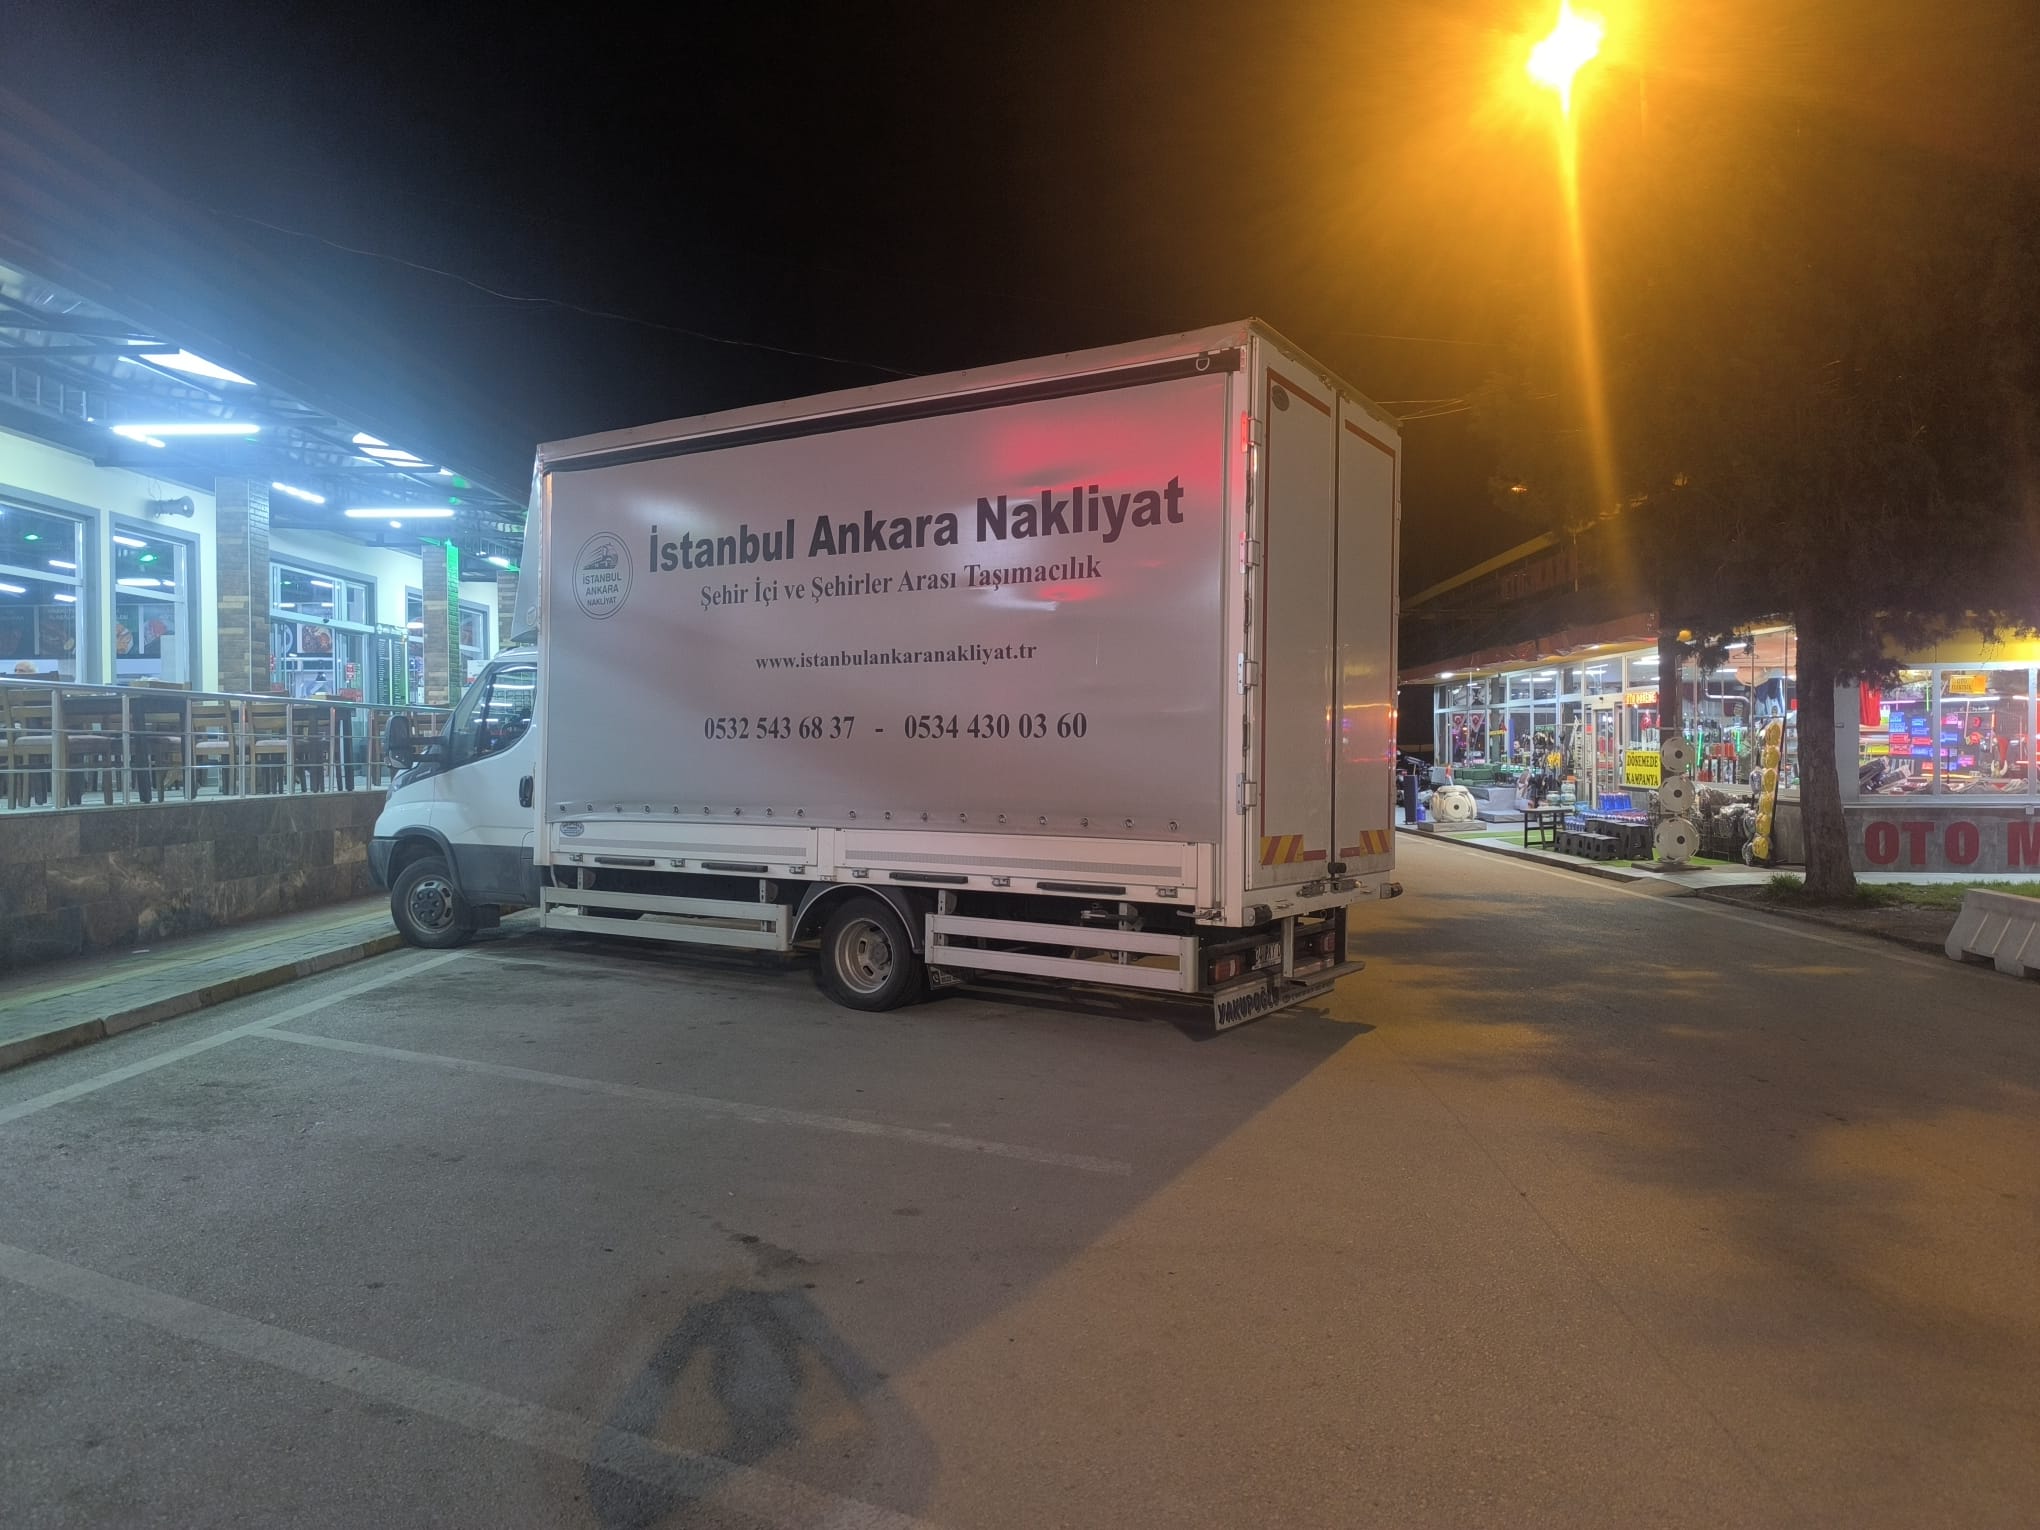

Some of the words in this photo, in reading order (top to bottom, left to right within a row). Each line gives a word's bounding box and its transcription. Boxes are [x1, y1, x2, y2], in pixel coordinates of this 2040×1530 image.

[650, 519, 795, 573] İstanbul
[807, 510, 959, 558] Ankara
[976, 476, 1185, 544] Nakliyat
[586, 584, 619, 596] ANKARA
[700, 584, 749, 611] Şehir
[754, 576, 778, 607] İçi
[783, 583, 806, 600] ve
[811, 573, 894, 604] Şehirler
[896, 569, 957, 593] Arası
[964, 555, 1102, 591] Taşımacılık
[755, 643, 1038, 670] www.istanbulankaranakliyat.tr
[704, 716, 750, 740] 0532
[756, 716, 792, 740] 543
[798, 715, 823, 740] 68
[829, 715, 855, 740] 37
[904, 714, 959, 739] 0534
[966, 713, 1010, 739] 430
[1018, 713, 1048, 739] 03
[1056, 712, 1087, 738] 60
[1625, 772, 1659, 786] KAMPANYA
[1864, 820, 1980, 865] OTO
